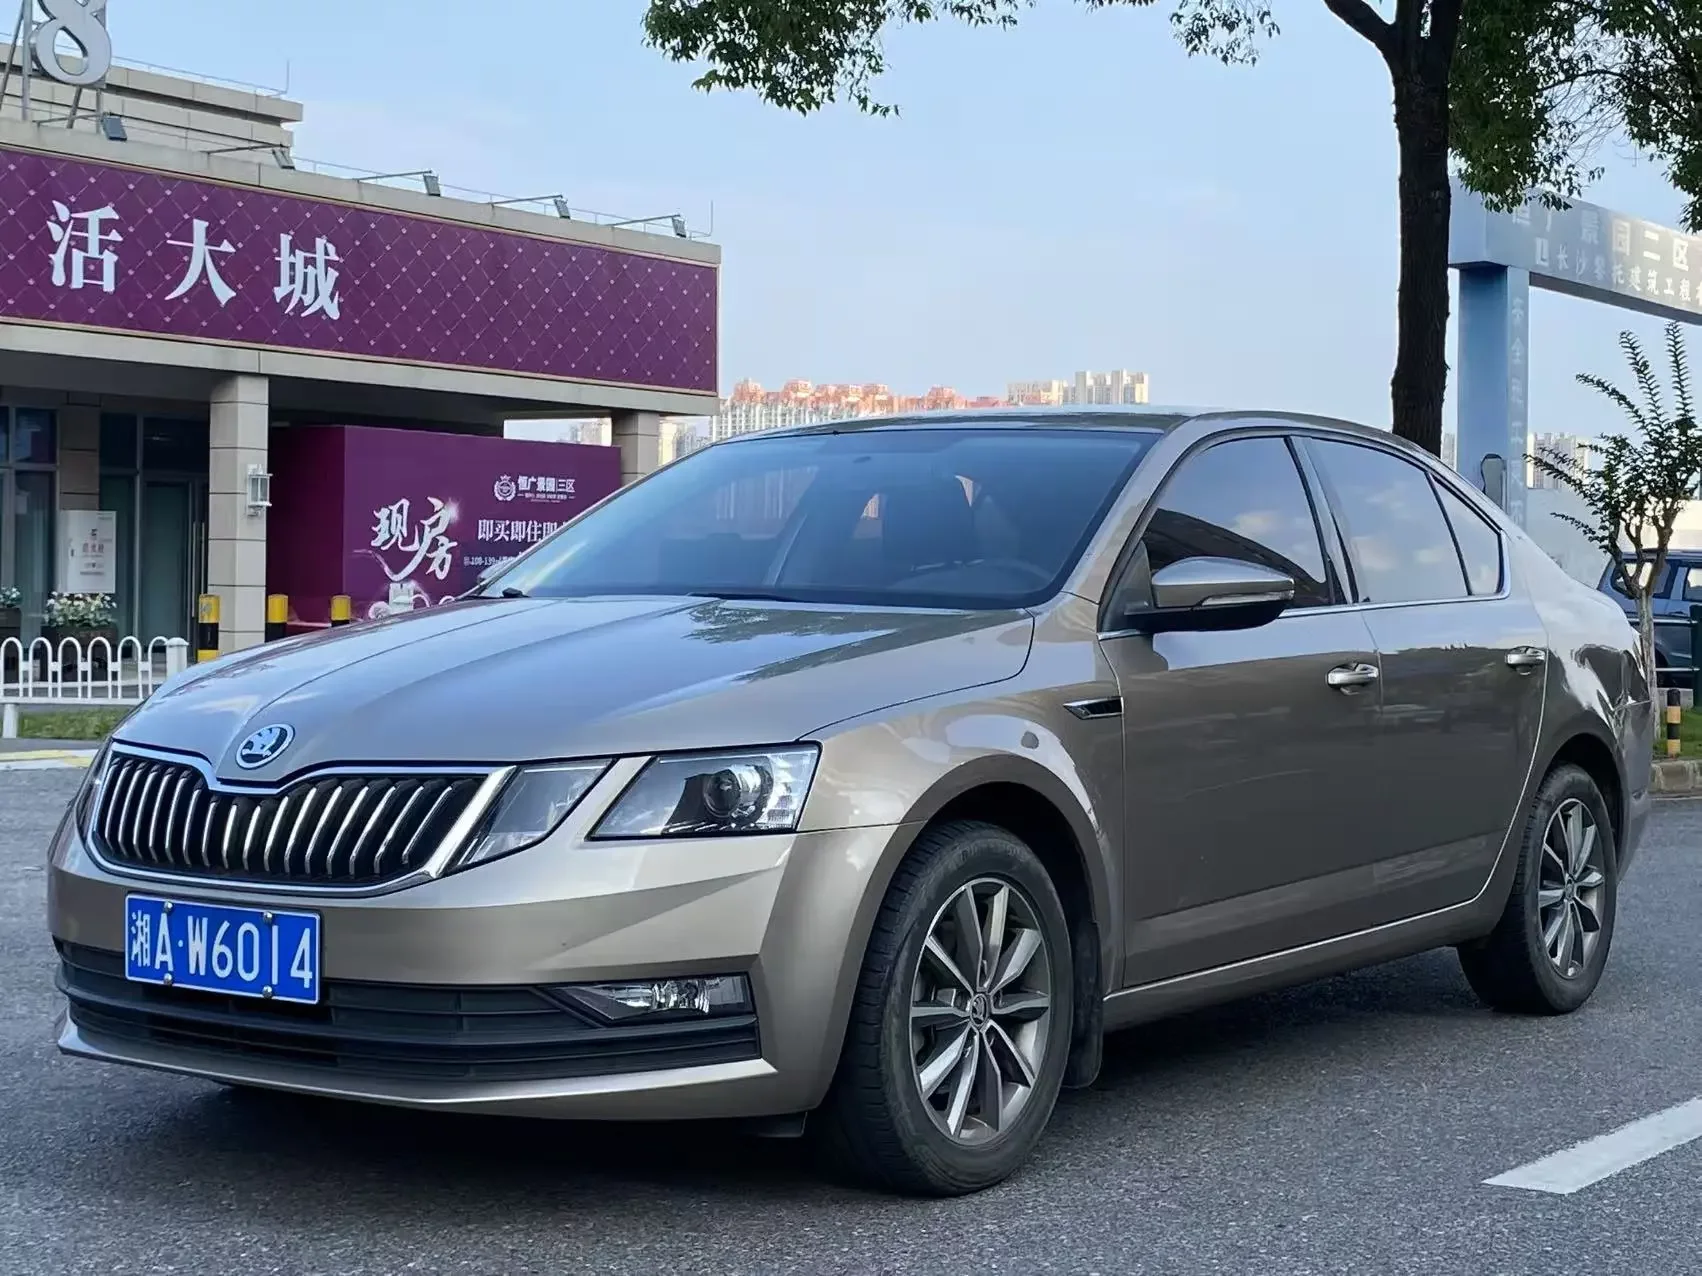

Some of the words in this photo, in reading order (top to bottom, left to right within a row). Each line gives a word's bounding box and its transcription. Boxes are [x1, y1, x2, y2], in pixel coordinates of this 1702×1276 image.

[46, 199, 342, 320] 活大城
[370, 497, 457, 581] 现房
[477, 518, 568, 543] 即买即住即
